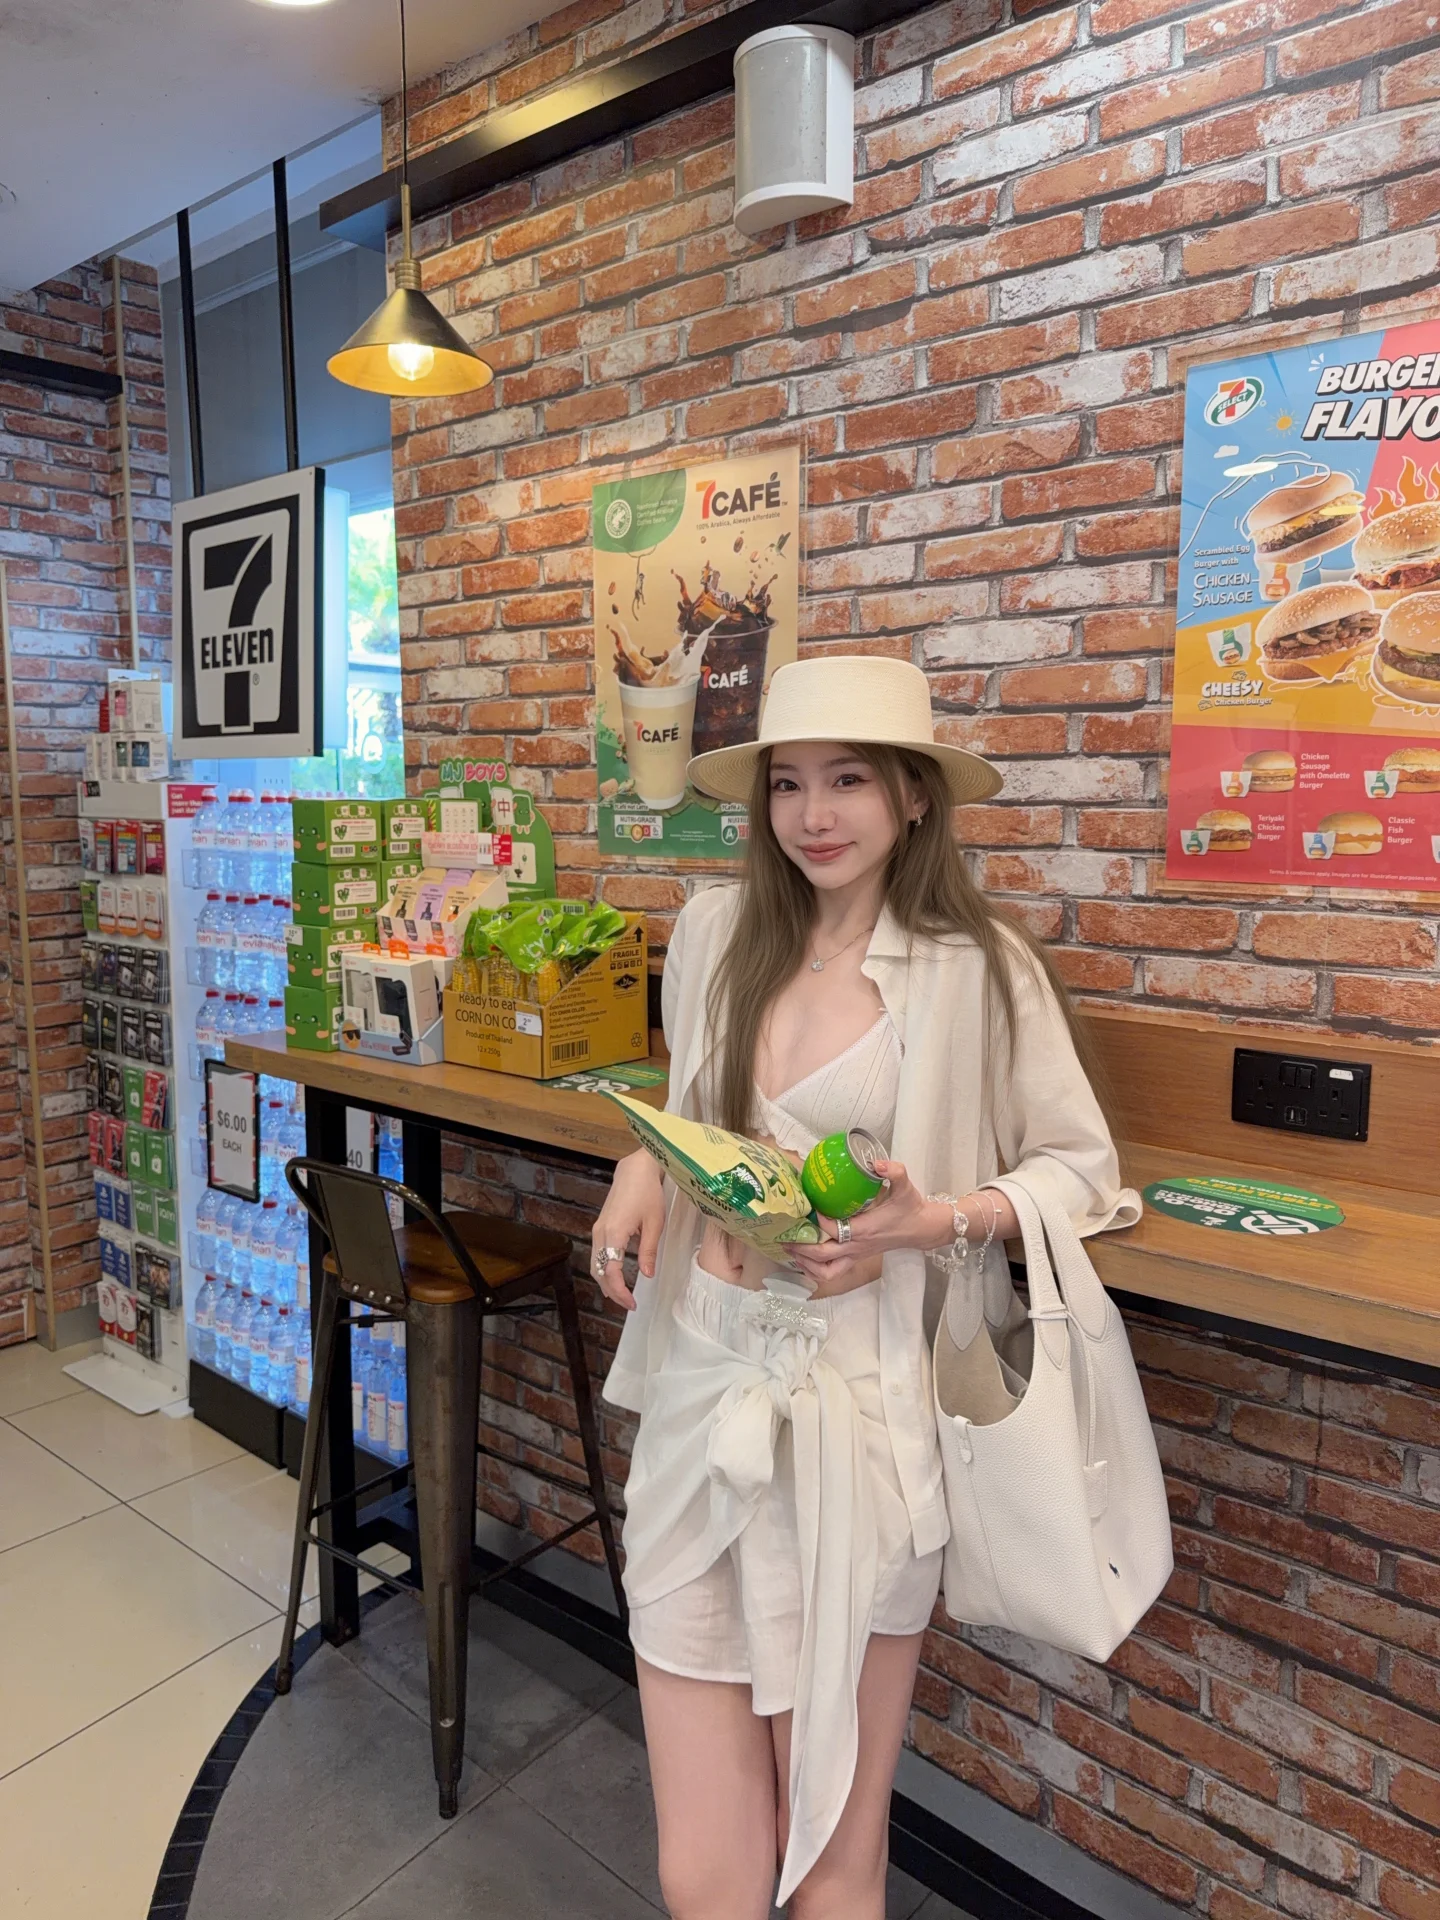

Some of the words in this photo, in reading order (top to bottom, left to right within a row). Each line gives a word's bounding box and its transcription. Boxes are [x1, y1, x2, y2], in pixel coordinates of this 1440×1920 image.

[1217, 391, 1247, 413] SELECT
[696, 523, 710, 531] 100%
[710, 519, 731, 528] Arabica,
[733, 517, 751, 525] Always
[752, 511, 781, 522] Affordable
[1194, 546, 1234, 557] Scrambled
[1236, 543, 1251, 555] Egg
[1194, 559, 1220, 569] Burger
[1222, 556, 1239, 566] with
[1193, 572, 1251, 590] CHICKEN
[1192, 590, 1253, 608] SAUSAGE
[1201, 680, 1264, 699] CHEESY
[1214, 696, 1245, 706] Chicken
[1246, 696, 1274, 707] Burger
[1301, 753, 1330, 761] Chicken
[464, 761, 508, 782] BOYS
[1300, 762, 1331, 772] Sausage
[1299, 771, 1316, 780] with
[1317, 771, 1350, 780] Omelette
[1299, 781, 1324, 790] Burger
[497, 798, 511, 818] 中
[1258, 814, 1285, 824] Teriyaki
[1388, 816, 1416, 825] Classic
[1257, 823, 1285, 832] Chicken
[1388, 826, 1404, 834] Fish
[1257, 833, 1281, 842] Burger
[1387, 836, 1414, 845] Burger
[612, 949, 640, 960] FRAGILE
[459, 994, 487, 1009] Ready
[489, 997, 500, 1008] to
[501, 1000, 517, 1011] eat
[455, 1009, 482, 1024] CORN
[484, 1013, 500, 1027] ON
[502, 1016, 517, 1030] CO
[465, 1030, 485, 1039] Product
[491, 1034, 513, 1044] Thailand
[477, 1045, 484, 1053] 12
[217, 1110, 247, 1134] $6.00
[222, 1139, 243, 1154] EACH
[1186, 1178, 1255, 1196] CLEAN
[1277, 1191, 1308, 1200] LOVE
